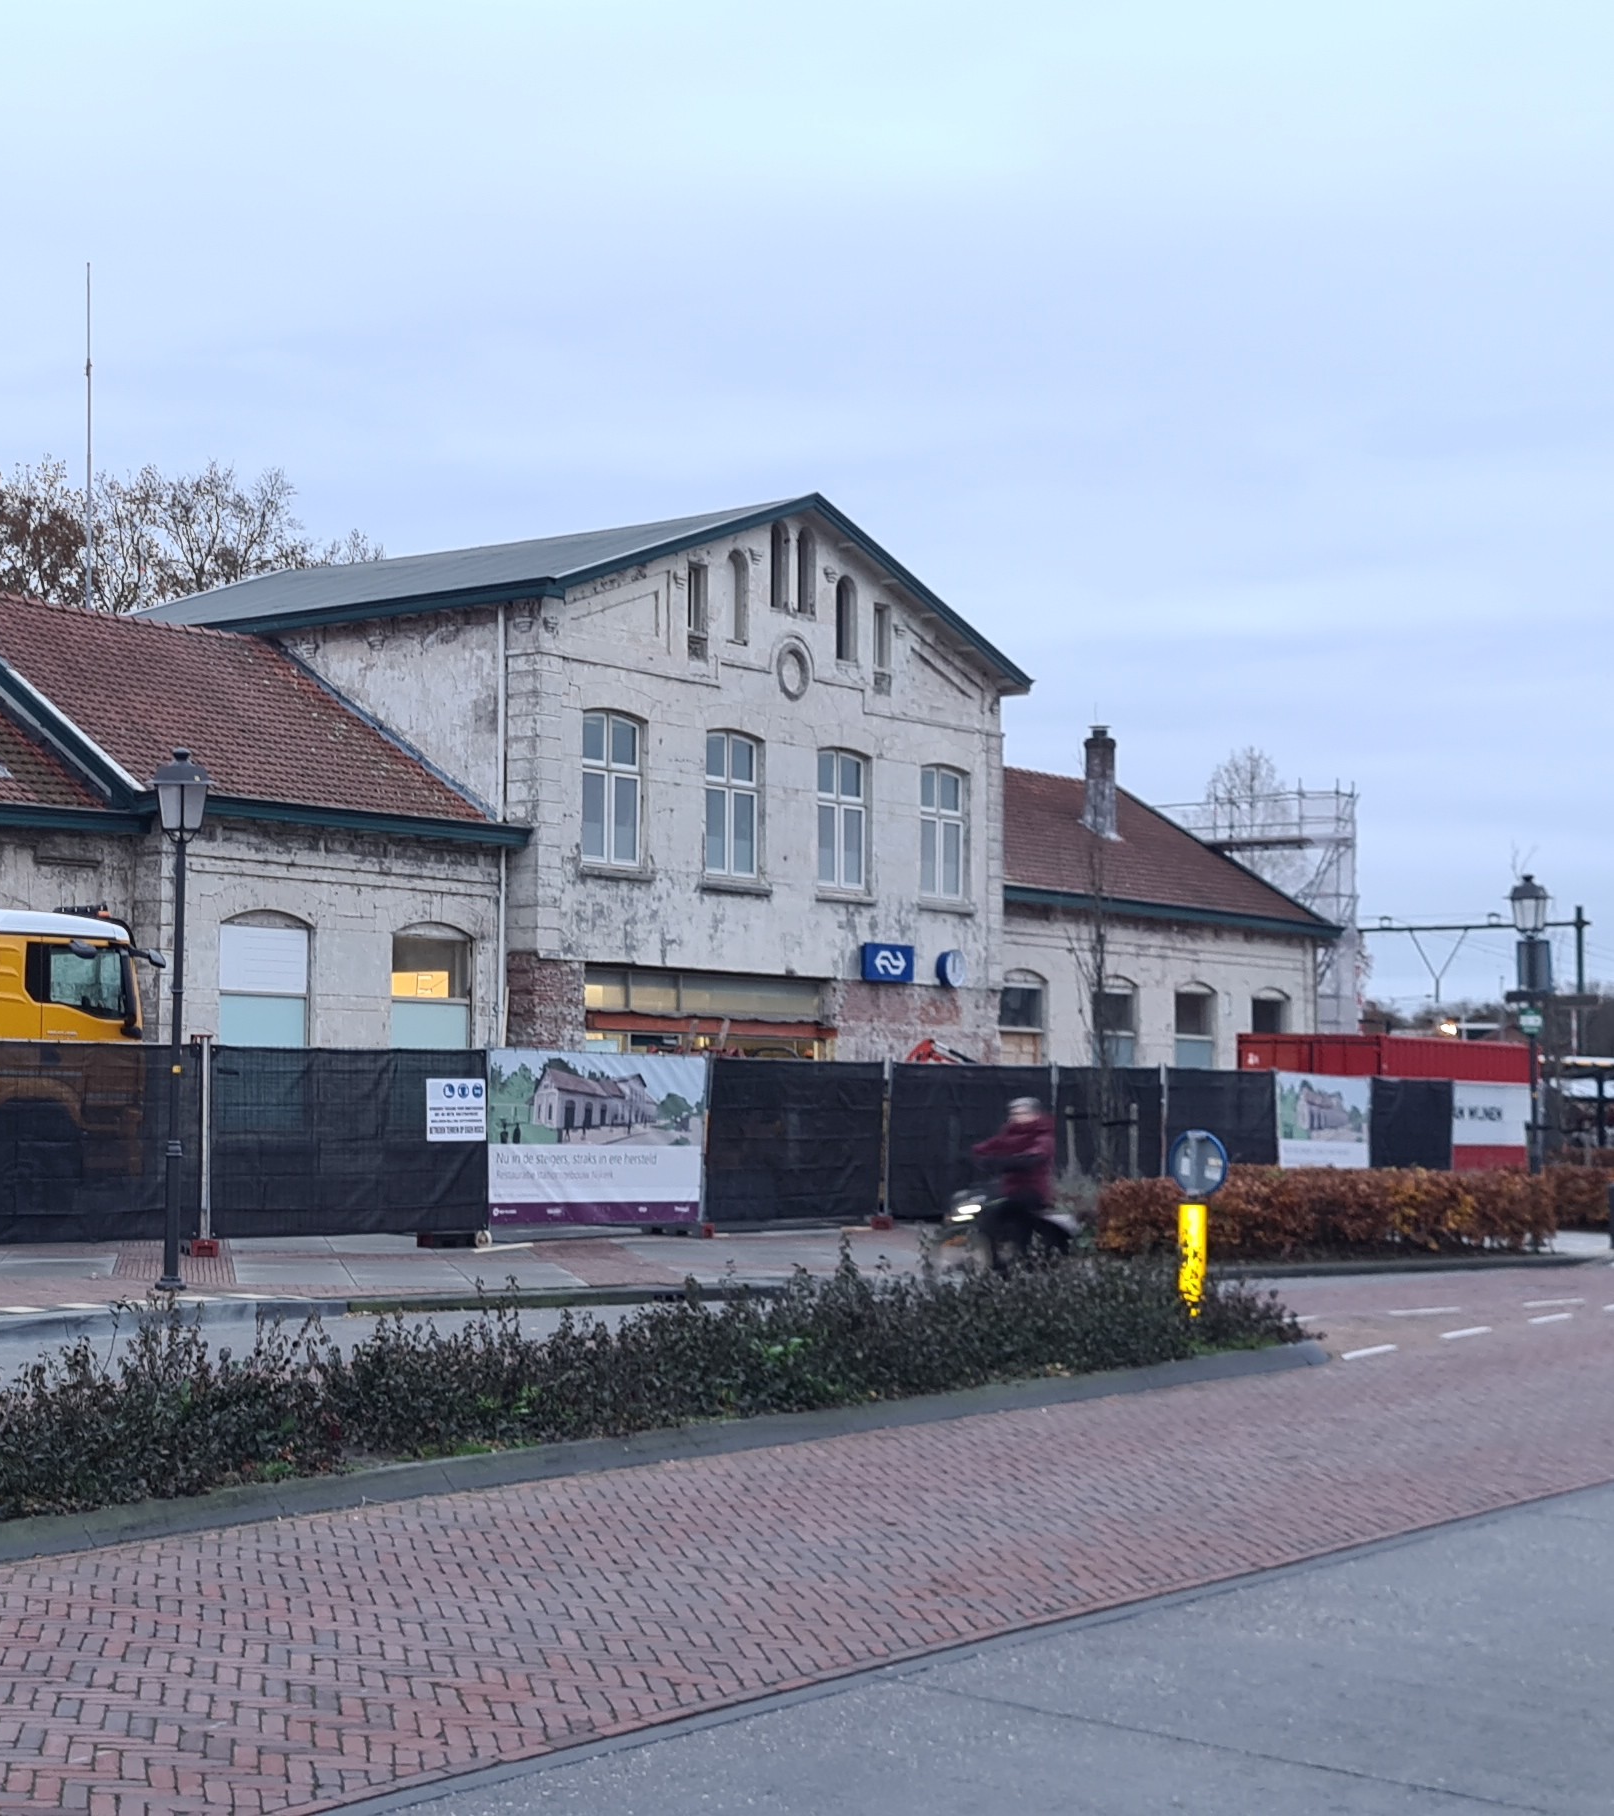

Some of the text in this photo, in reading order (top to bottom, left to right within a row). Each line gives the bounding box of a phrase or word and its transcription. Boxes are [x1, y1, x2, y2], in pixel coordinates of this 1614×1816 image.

[496, 1152, 510, 1165] Nu
[523, 1152, 534, 1165] de
[573, 1152, 597, 1165] straks
[609, 1154, 623, 1165] ere
